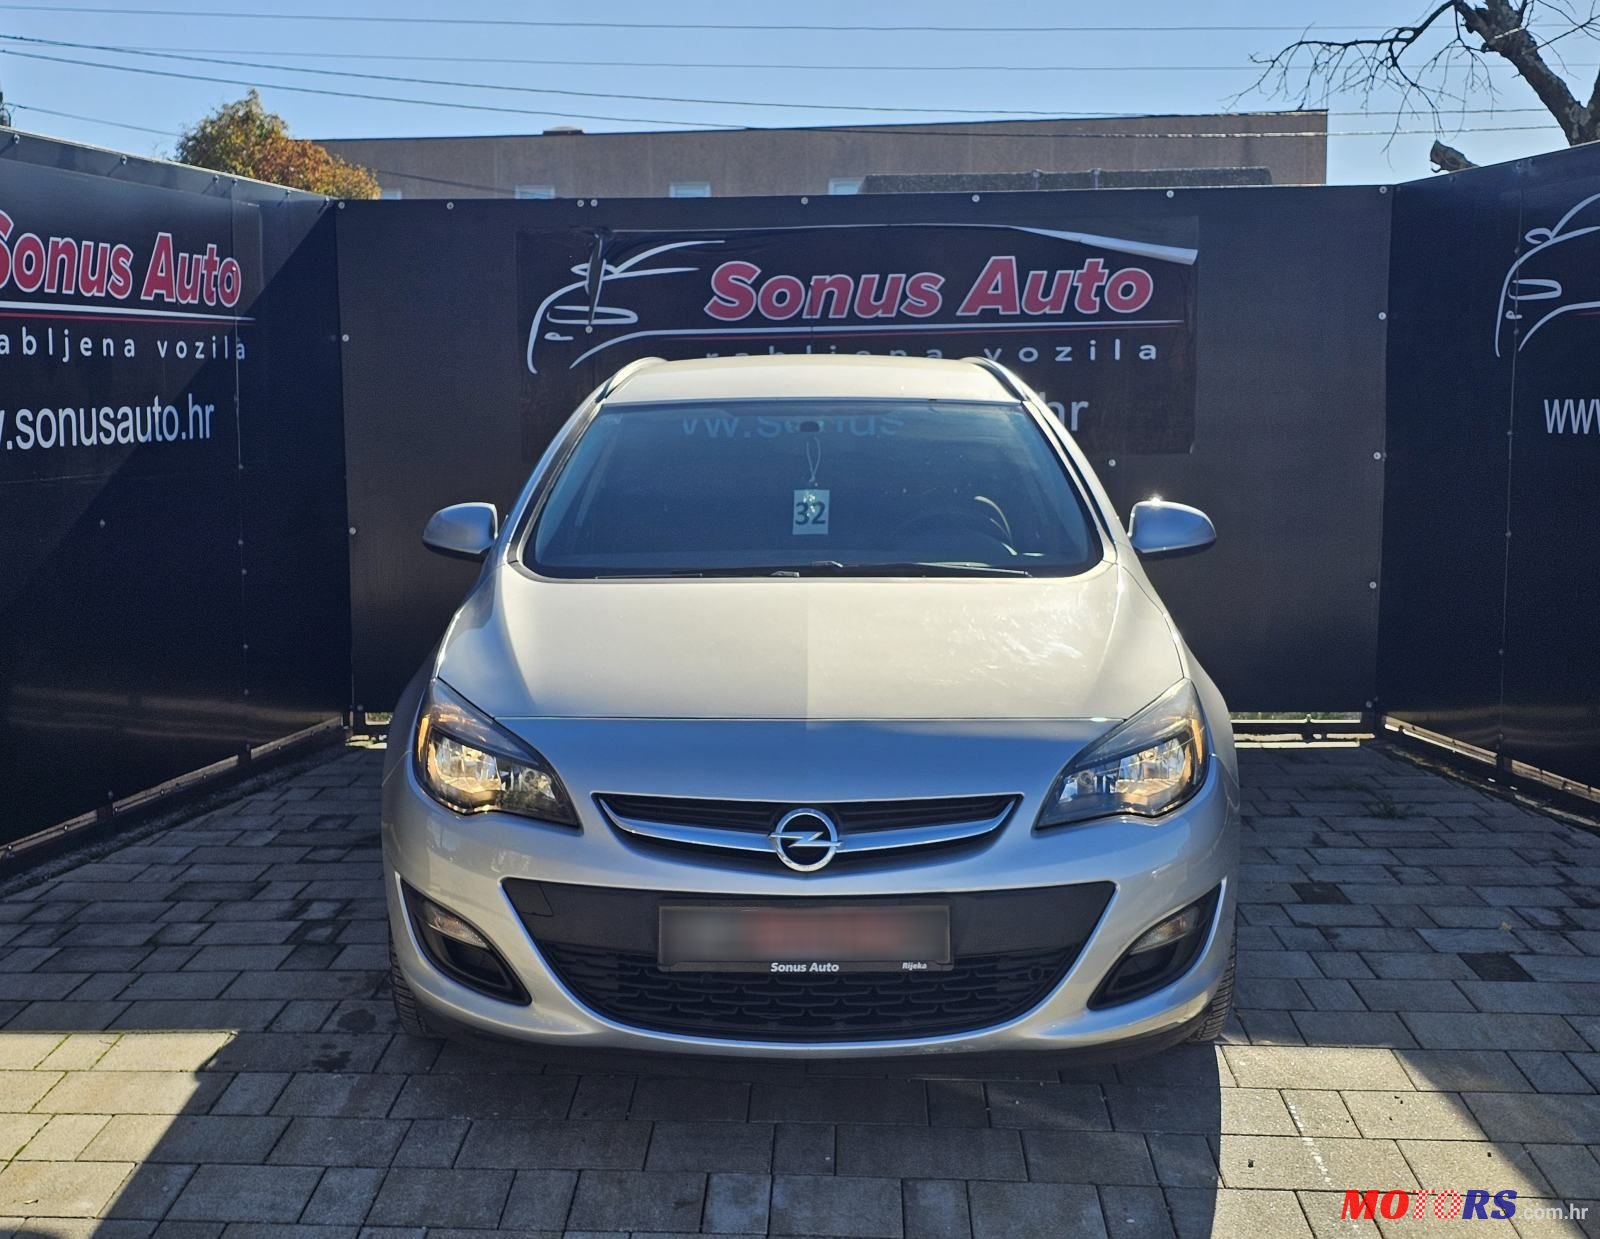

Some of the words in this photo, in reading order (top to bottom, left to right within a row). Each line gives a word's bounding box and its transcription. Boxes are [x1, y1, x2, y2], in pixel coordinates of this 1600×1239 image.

[140, 232, 242, 308] Auto
[703, 260, 946, 321] Sonus
[955, 255, 1154, 316] Auto
[156, 335, 246, 360] vozila
[983, 338, 1157, 363] vozila
[0, 393, 215, 450] .sonusauto.hr
[795, 501, 826, 526] 32
[770, 962, 807, 973] Sonus
[809, 962, 839, 973] Auto
[902, 961, 928, 971] Rijeka
